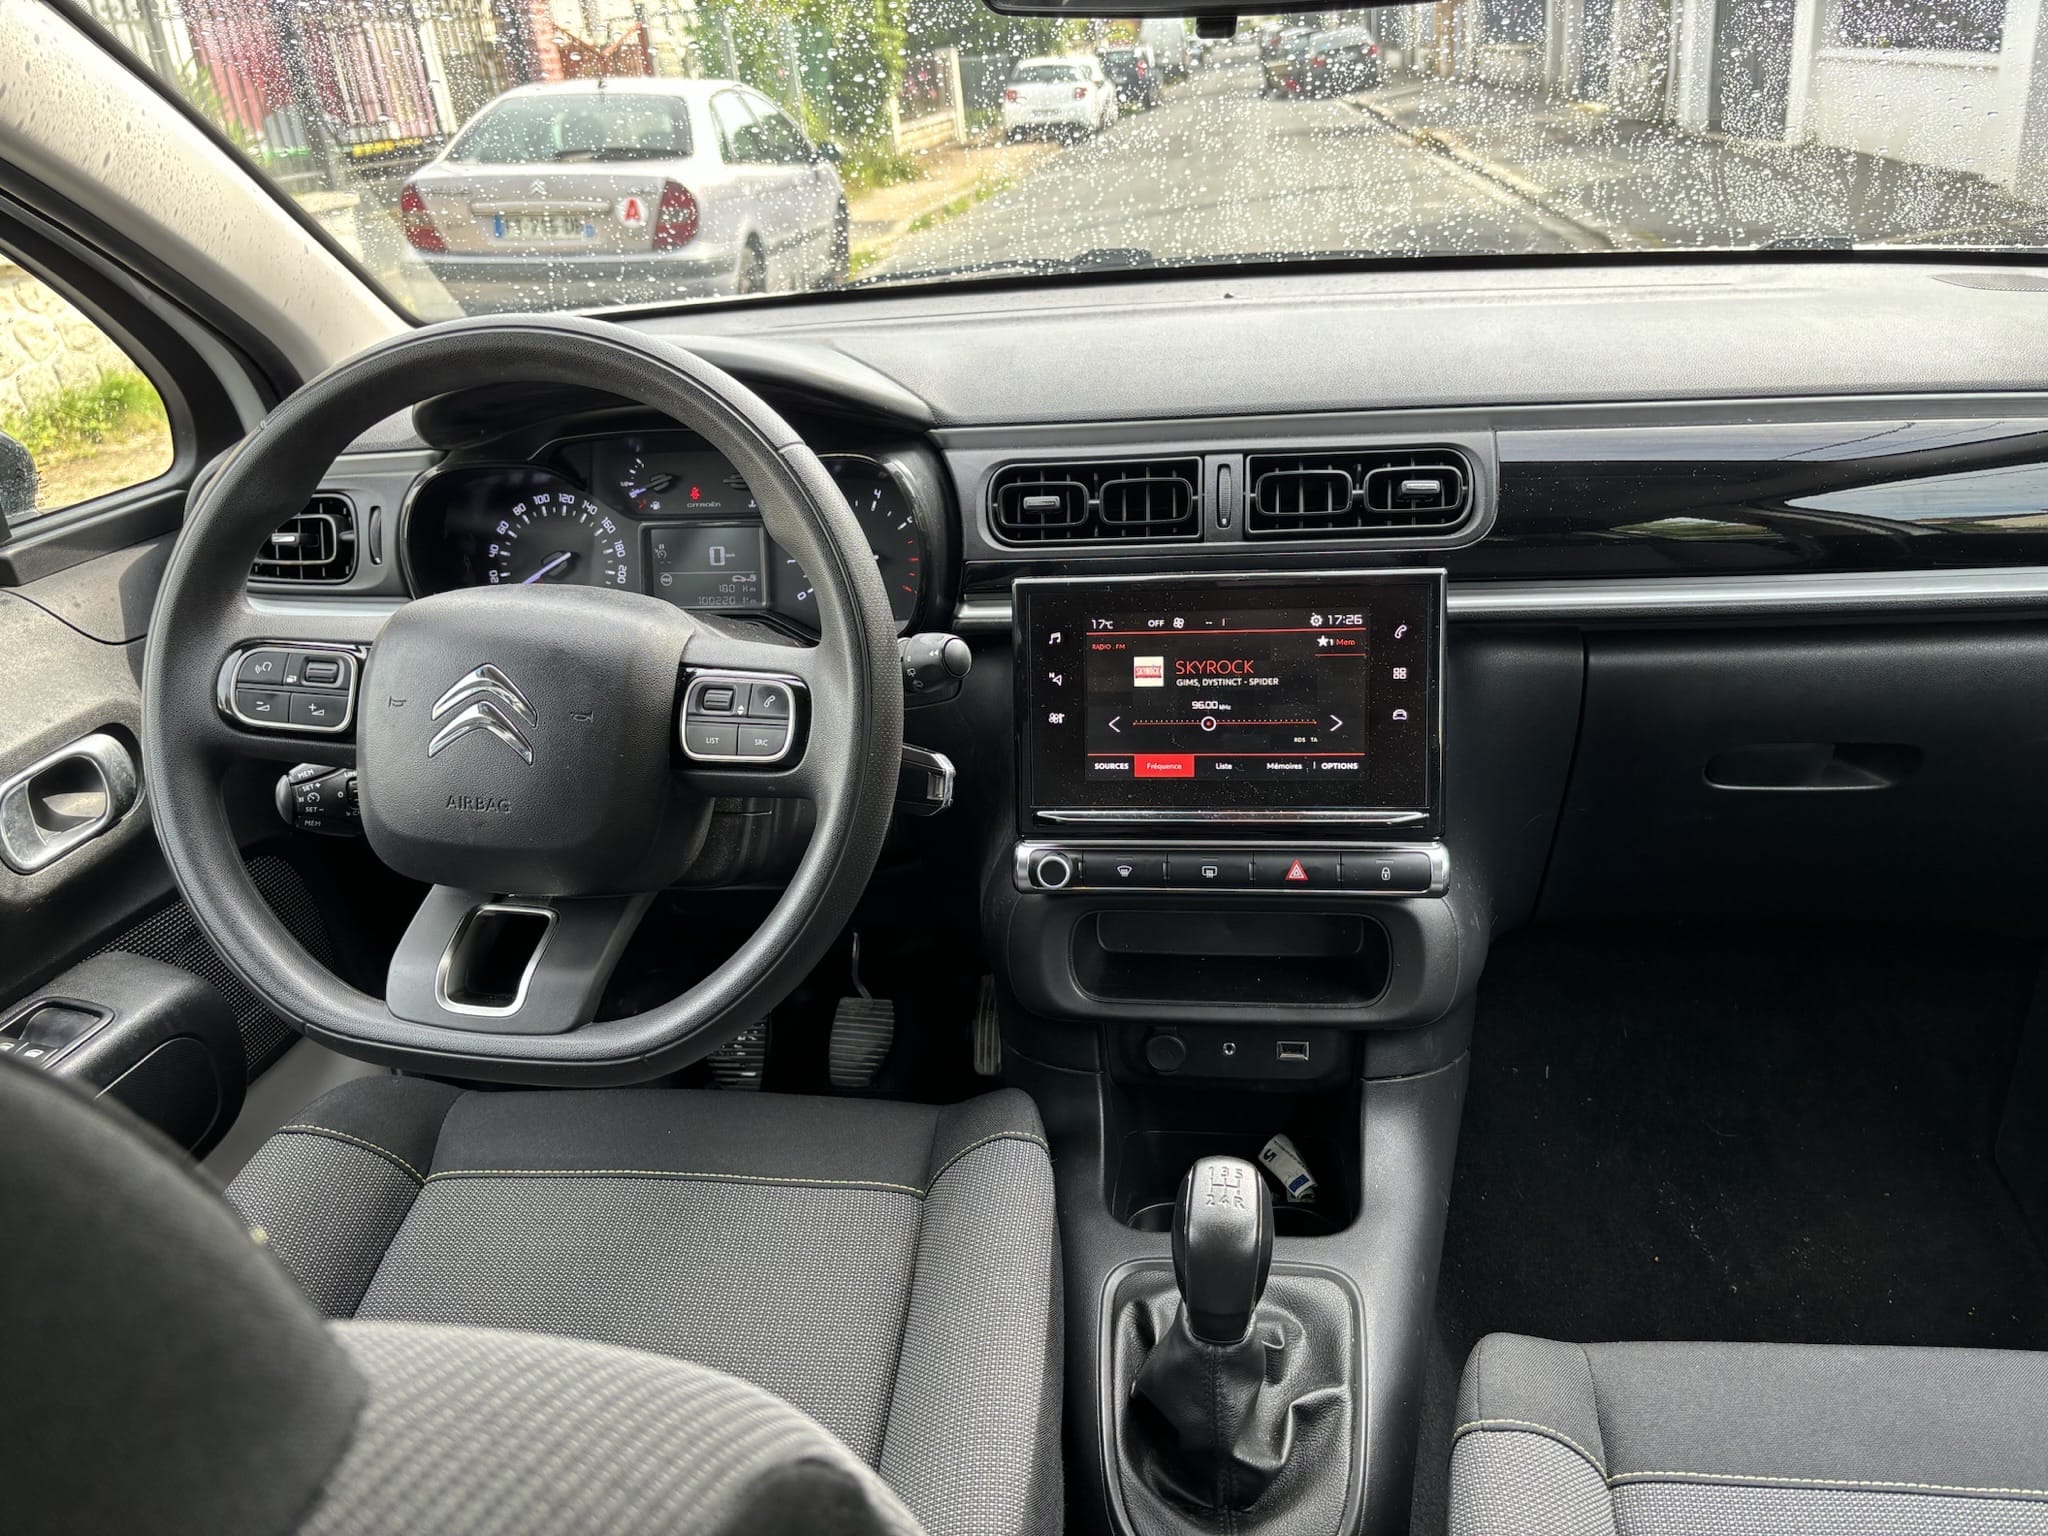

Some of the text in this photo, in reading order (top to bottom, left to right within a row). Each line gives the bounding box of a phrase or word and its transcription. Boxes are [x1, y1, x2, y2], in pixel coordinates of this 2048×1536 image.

[624, 198, 641, 222] A
[533, 493, 551, 505] 100
[558, 493, 575, 504] 120
[874, 489, 881, 499] 4
[512, 503, 527, 516] 80
[582, 500, 598, 515] 140
[496, 521, 509, 535] 60
[601, 517, 616, 534] 160
[488, 544, 500, 558] 40
[614, 540, 626, 558] 180
[709, 546, 726, 566] 0
[488, 570, 499, 583] 20
[617, 565, 627, 584] 200
[719, 584, 736, 593] 180
[1147, 619, 1165, 628] OFF
[1328, 614, 1363, 625] 17:26
[1175, 660, 1254, 675] SKYROCK
[1176, 678, 1200, 687] GIMS,
[1202, 678, 1242, 687] DYSTINCT
[1249, 678, 1279, 686] SPIDER
[1146, 762, 1182, 771] Fréquence
[1266, 762, 1303, 770] Mémoires
[1321, 762, 1358, 770] OPTIONS
[298, 769, 314, 779] MEM
[302, 784, 314, 792] SET
[445, 795, 512, 814] AIRBAG
[1221, 1166, 1229, 1177] 3
[1235, 1168, 1243, 1179] 5
[1206, 1194, 1246, 1209] 2 4 R
